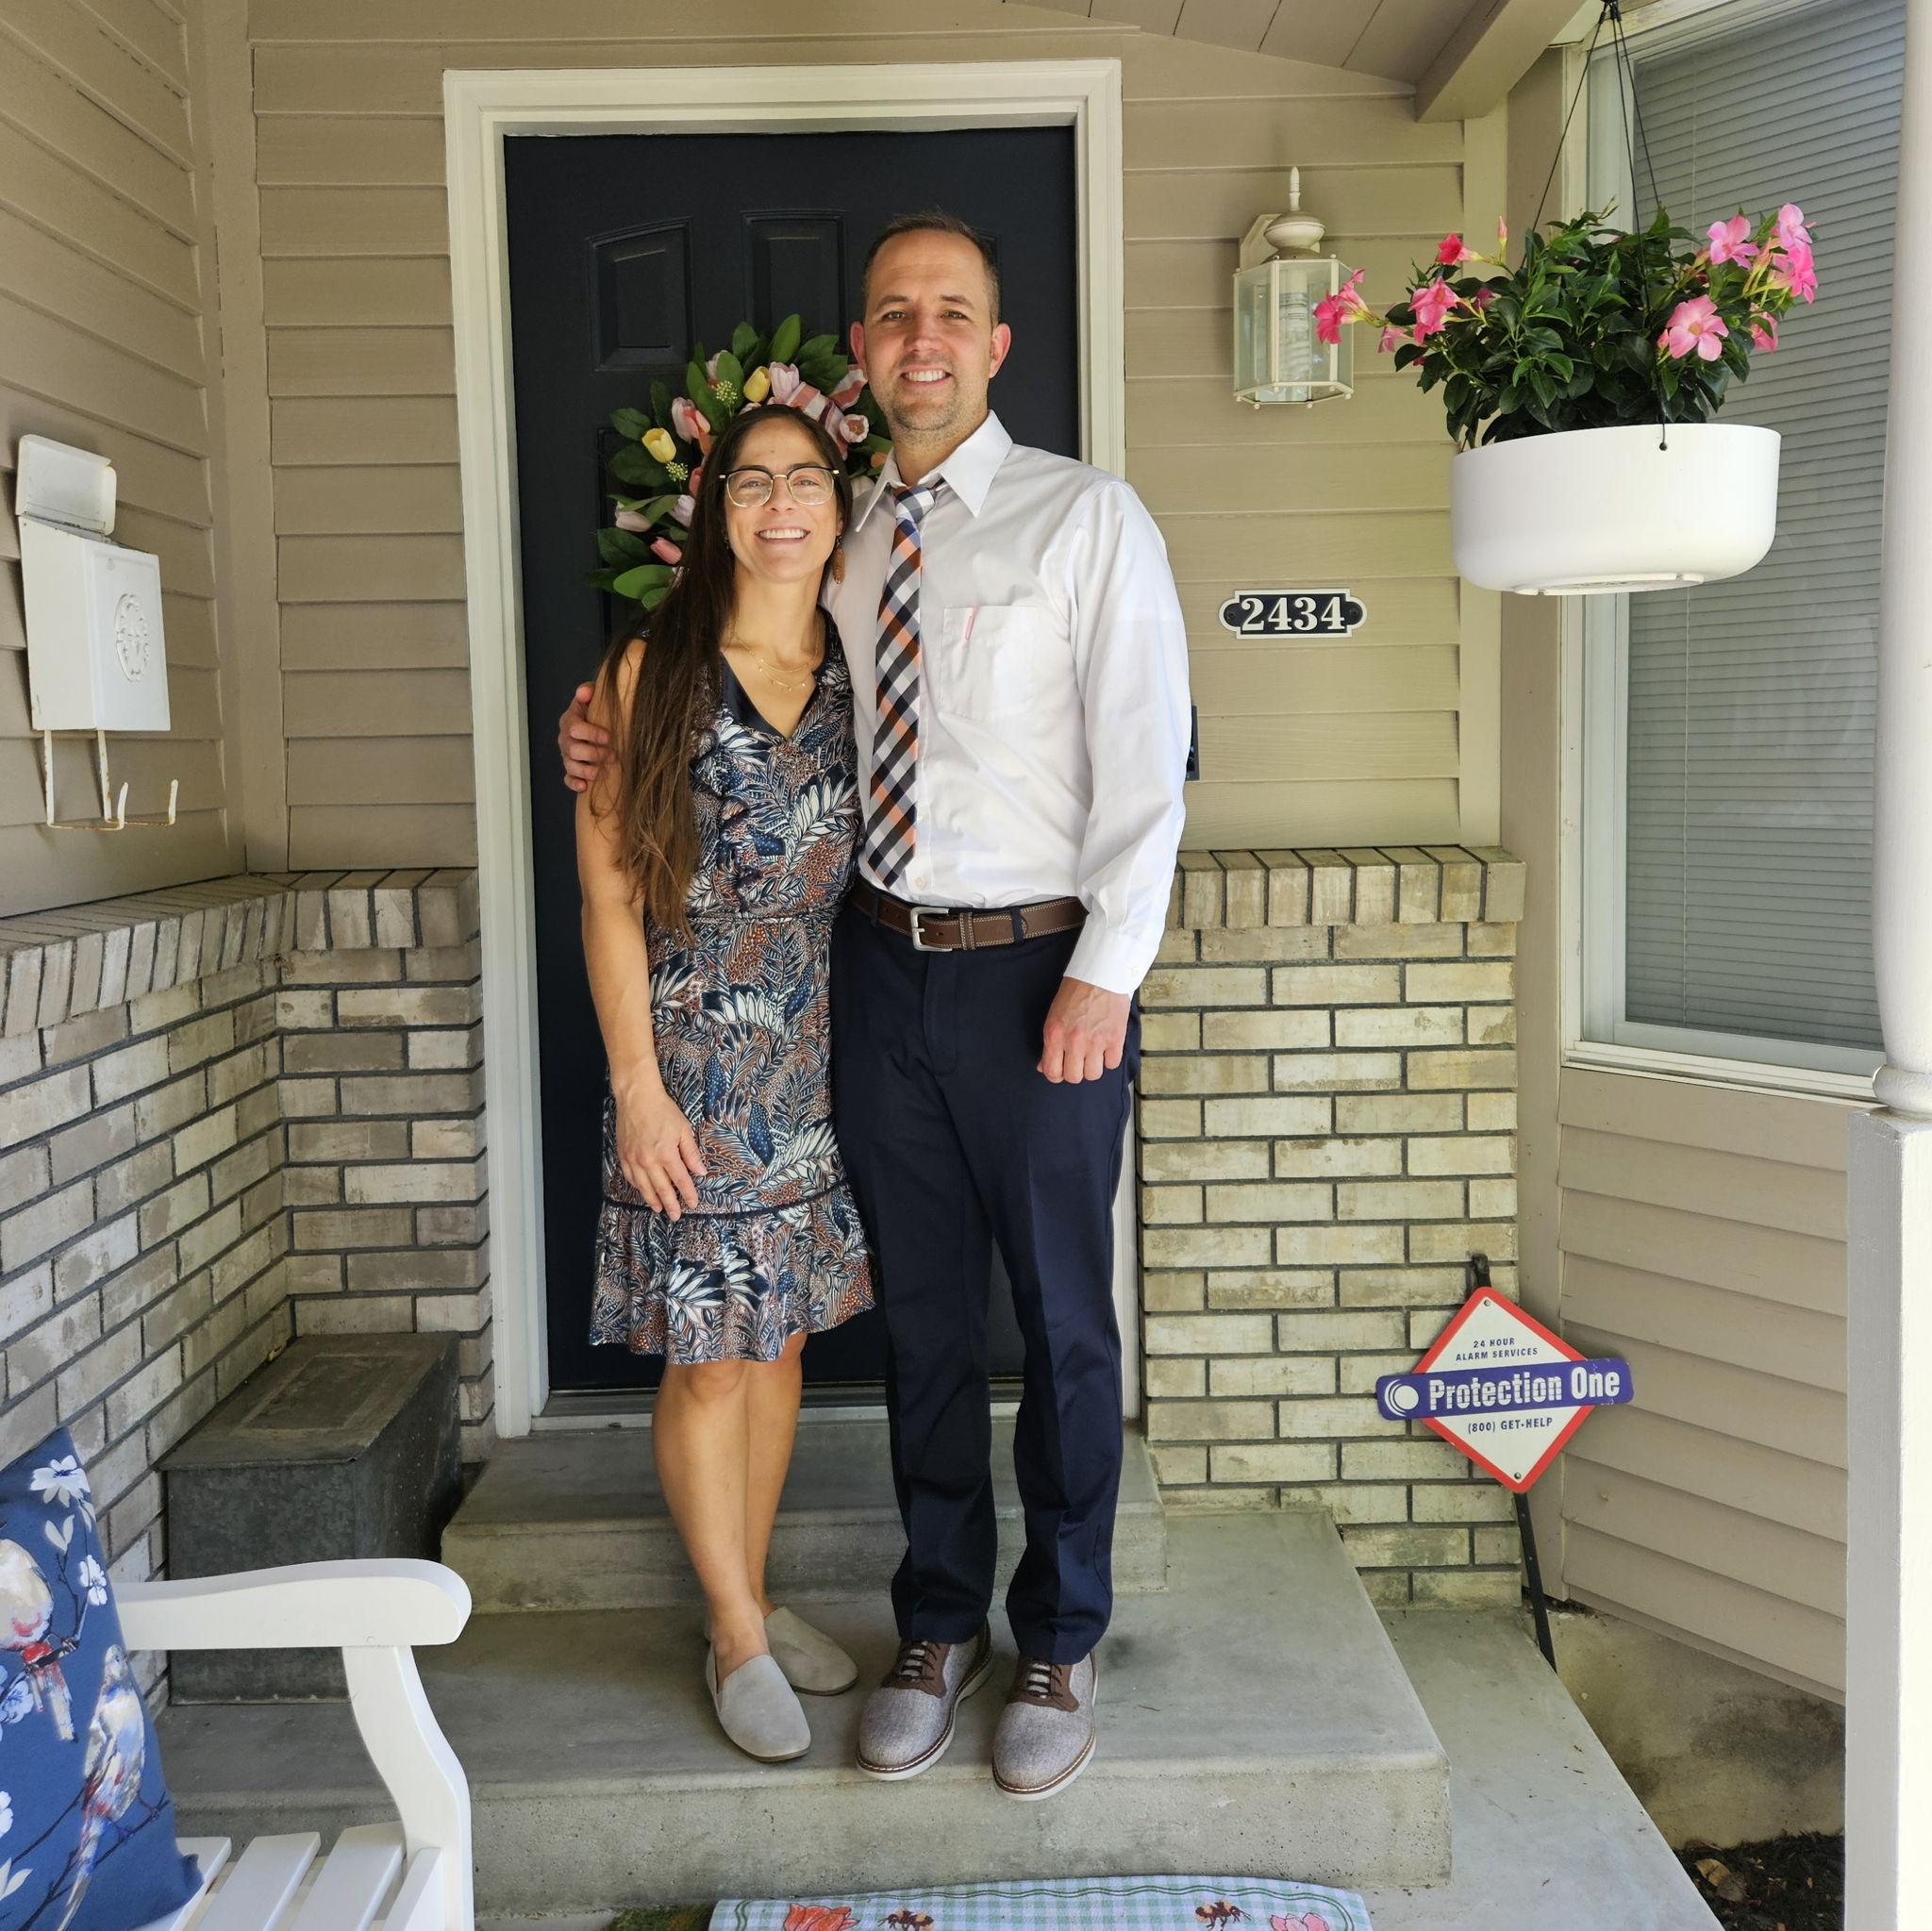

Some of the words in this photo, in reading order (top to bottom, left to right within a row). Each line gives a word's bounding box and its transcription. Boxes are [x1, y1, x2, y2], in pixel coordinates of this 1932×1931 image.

[1241, 596, 1346, 631] 2434
[1473, 1340, 1486, 1349] 24
[1490, 1337, 1515, 1347] HOUR
[1456, 1351, 1489, 1361] ALARM
[1492, 1347, 1539, 1359] SERVICES
[1428, 1372, 1562, 1411] Protection
[1571, 1366, 1621, 1399] One
[1468, 1422, 1496, 1435] (800)
[1501, 1417, 1554, 1431] GET-HELP
